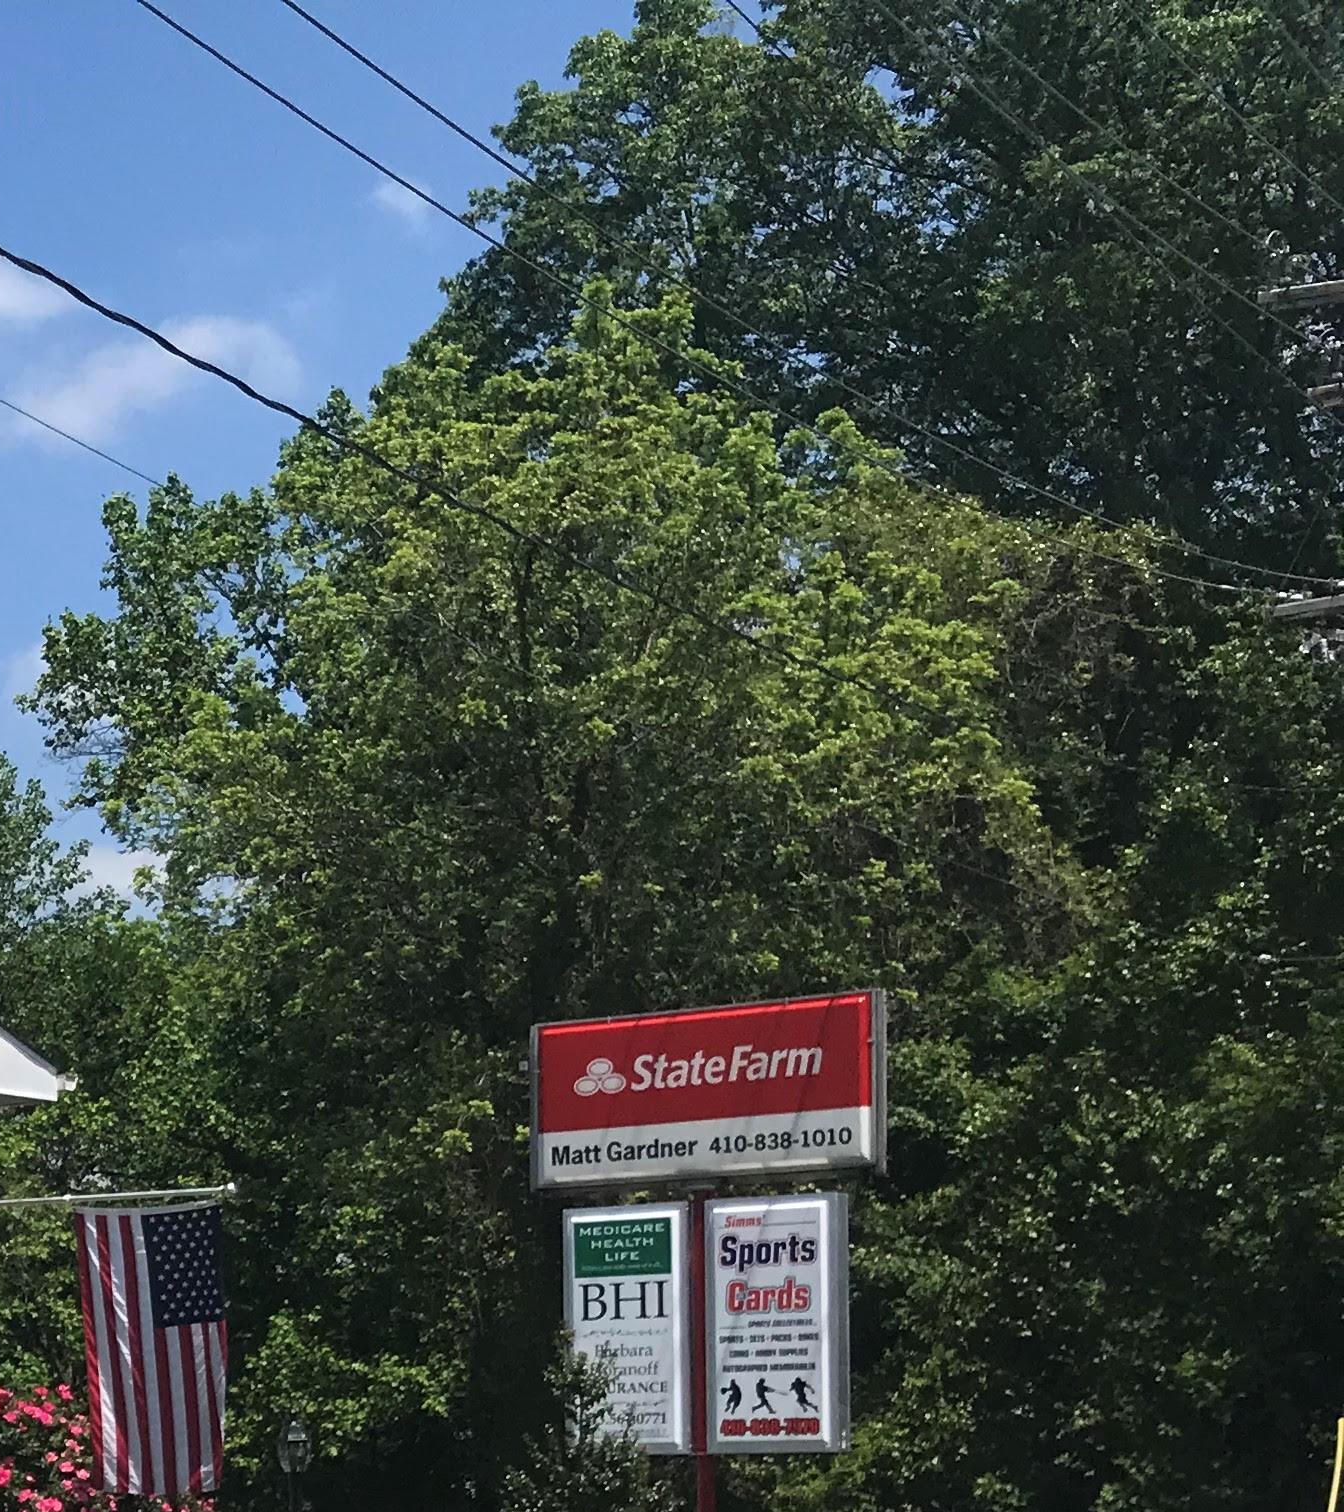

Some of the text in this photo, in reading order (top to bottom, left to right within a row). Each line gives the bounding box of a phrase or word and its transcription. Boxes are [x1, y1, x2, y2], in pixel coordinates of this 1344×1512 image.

[551, 1126, 853, 1166] Matt Gardner 410-838-1010
[579, 1223, 665, 1237] MEDICARE
[590, 1237, 654, 1249] HEALTH
[604, 1251, 640, 1262] LIFE
[719, 1233, 817, 1273] Sports
[578, 1280, 669, 1322] BHI
[726, 1276, 811, 1315] Cards
